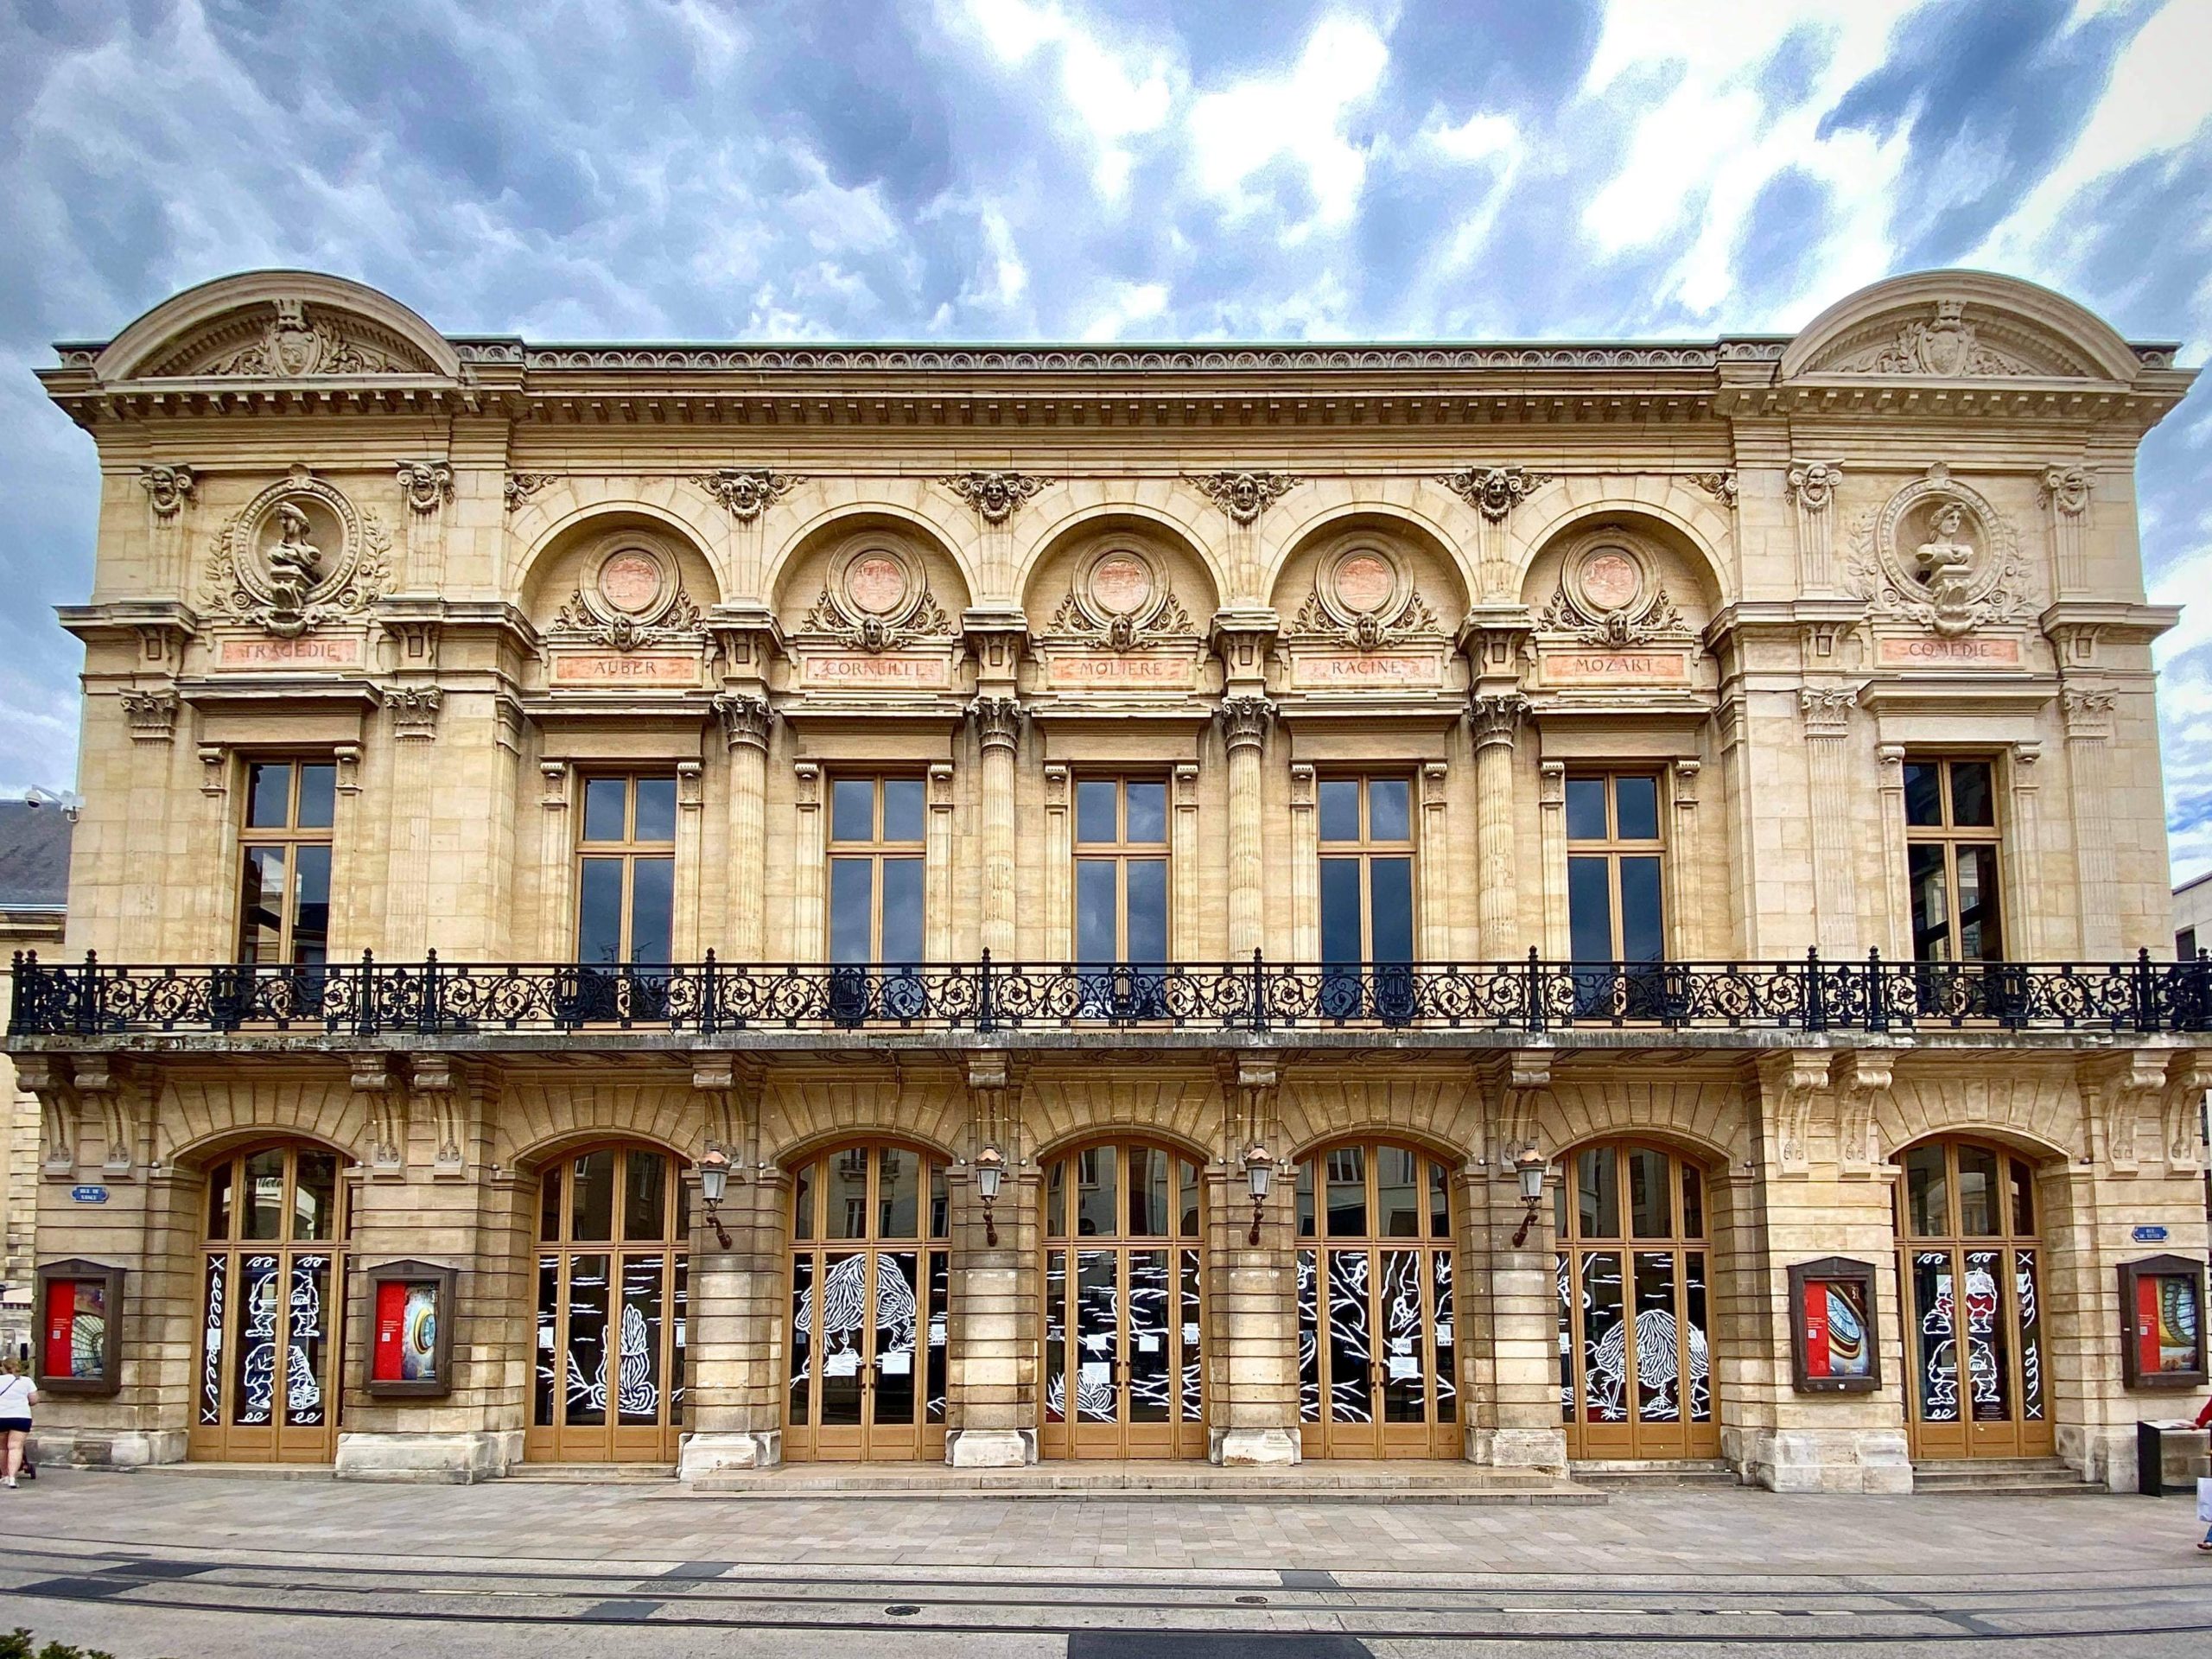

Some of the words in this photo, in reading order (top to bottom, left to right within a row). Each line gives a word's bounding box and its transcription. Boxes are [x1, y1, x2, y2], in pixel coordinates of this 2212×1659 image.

[245, 643, 338, 658] TRAGEDIE
[1909, 642, 1991, 658] COMEDIE
[594, 660, 657, 675] AUBER
[825, 661, 926, 677] CORNEILLE
[1079, 662, 1163, 676] MOLIERE
[1332, 660, 1402, 675] RACINE
[1575, 658, 1654, 672] MOZART
